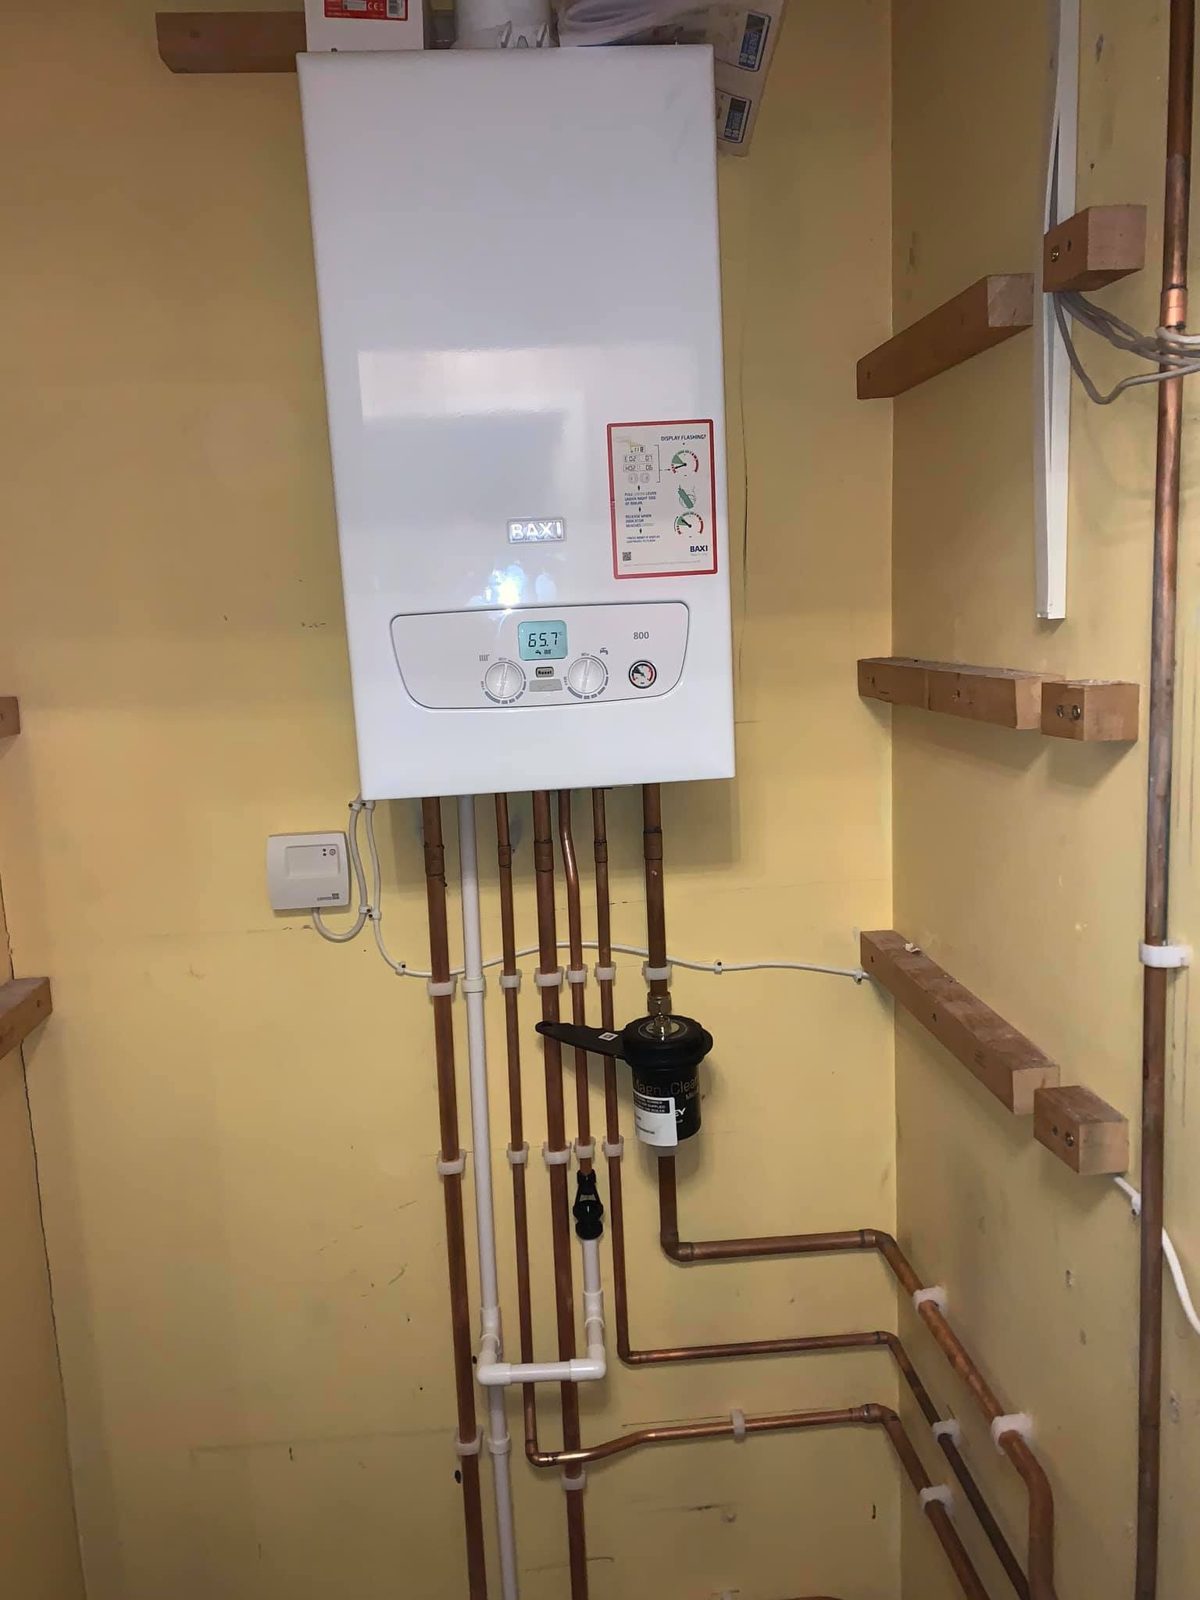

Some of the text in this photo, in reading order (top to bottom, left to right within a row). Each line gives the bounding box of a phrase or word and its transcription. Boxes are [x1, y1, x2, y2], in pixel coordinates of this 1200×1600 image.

[510, 522, 562, 539] BAXI
[528, 632, 558, 647] 65.7
[633, 631, 650, 640] 800
